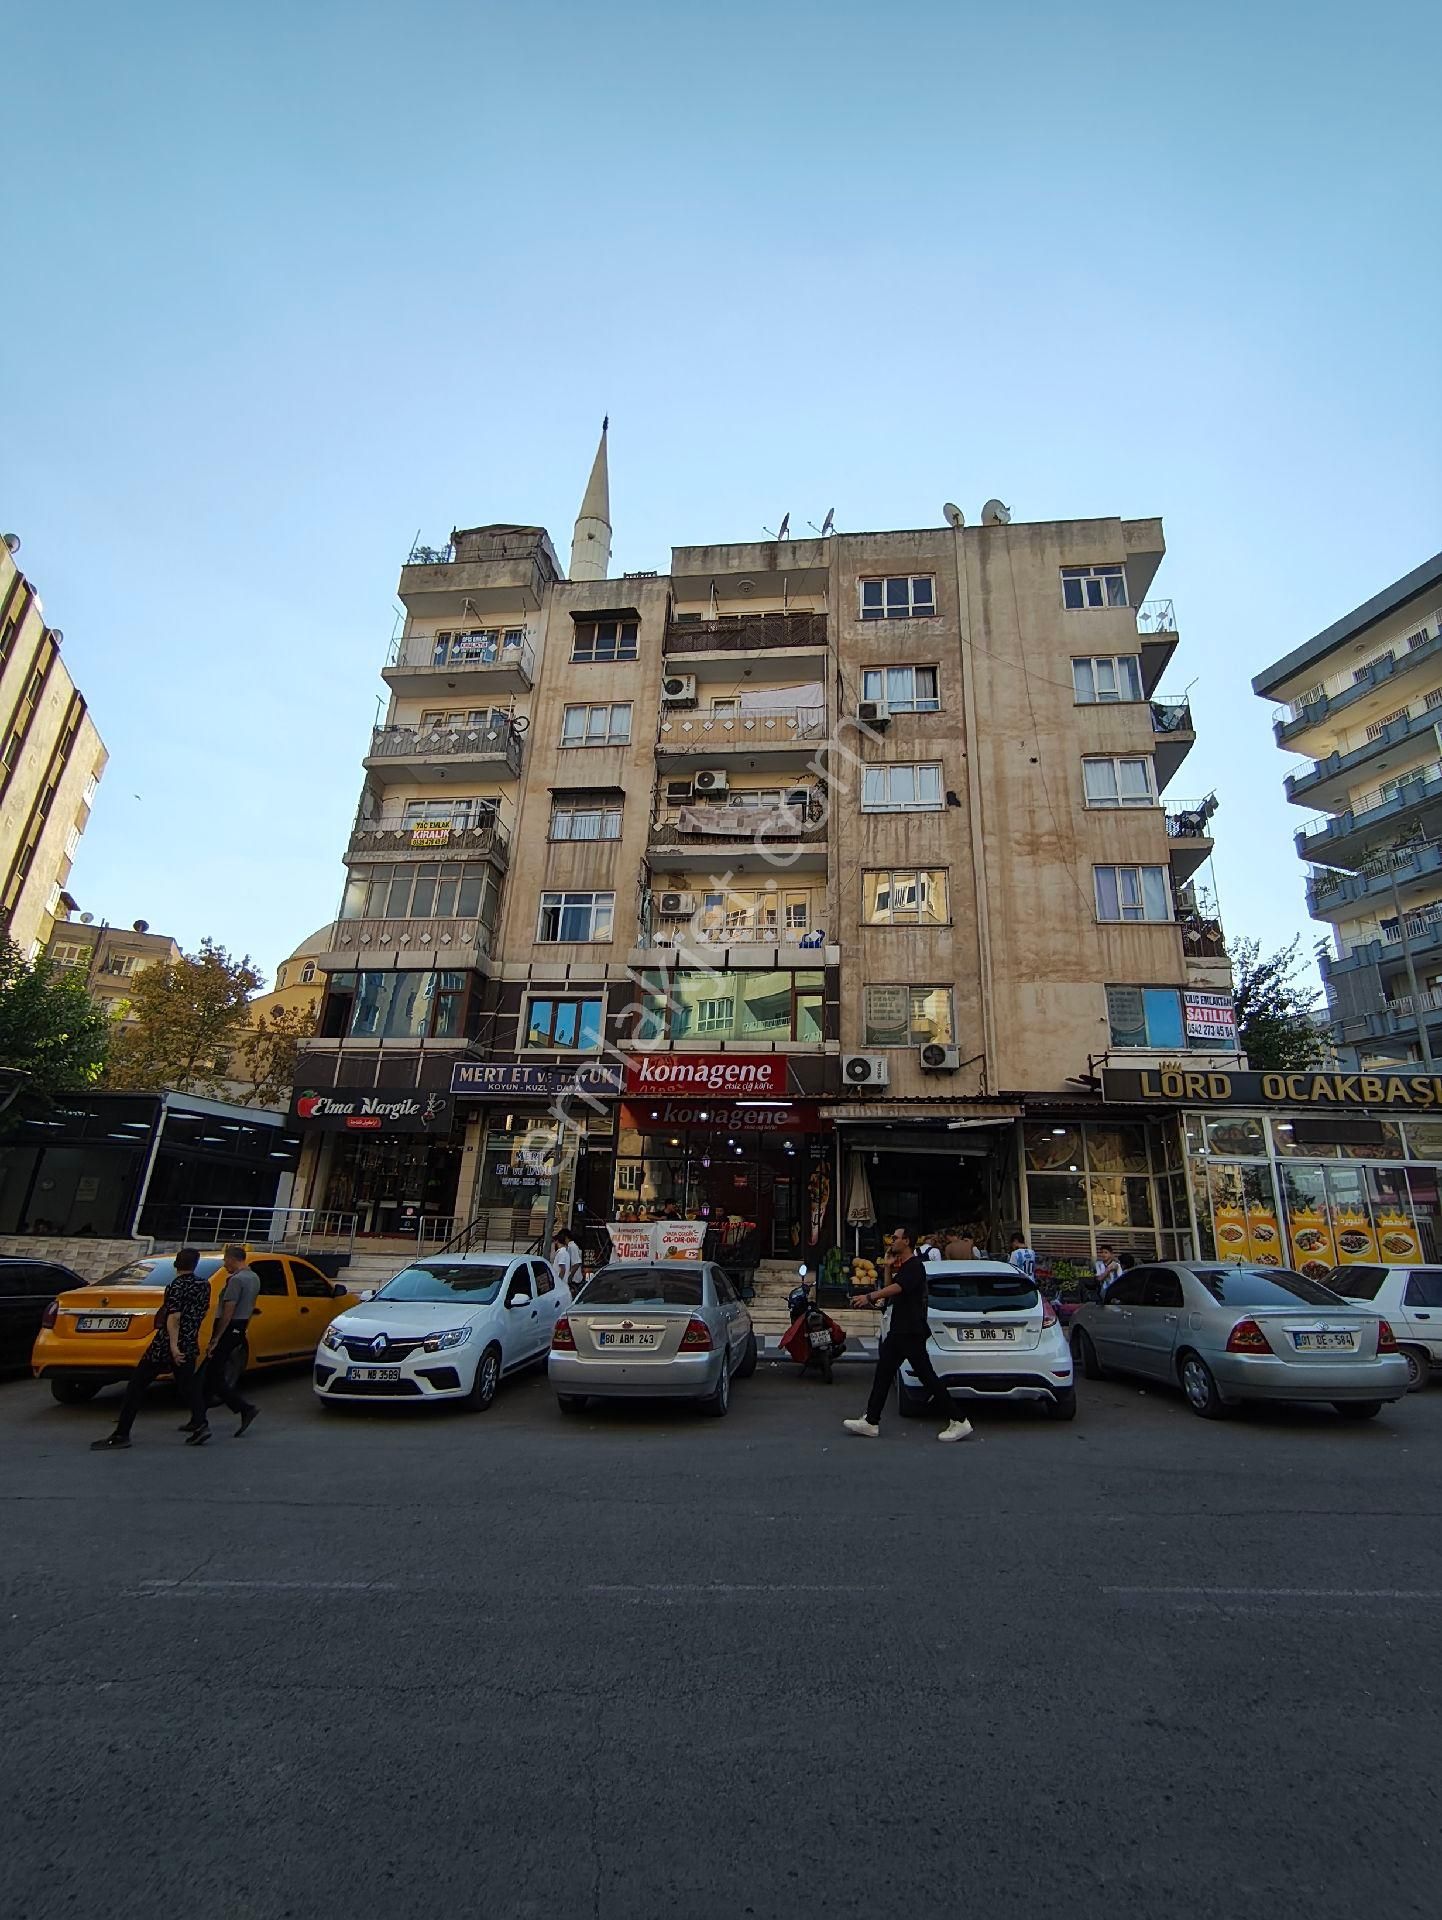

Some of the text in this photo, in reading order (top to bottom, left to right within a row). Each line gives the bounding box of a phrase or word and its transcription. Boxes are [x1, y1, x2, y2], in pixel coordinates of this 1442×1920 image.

[1186, 1007, 1233, 1024] SATILIK
[459, 1067, 507, 1083] MERT
[511, 1067, 533, 1083] ET
[639, 1057, 772, 1090] komagene
[488, 1083, 519, 1091] KOYUN
[754, 1081, 774, 1090] köfte
[1139, 1071, 1232, 1099] LORD
[311, 1097, 421, 1120] Elma Nargile
[617, 1242, 631, 1258] 50
[638, 1334, 654, 1344] 243
[963, 1330, 975, 1339] 35
[1001, 1329, 1013, 1339] 75
[351, 1369, 361, 1380] 34
